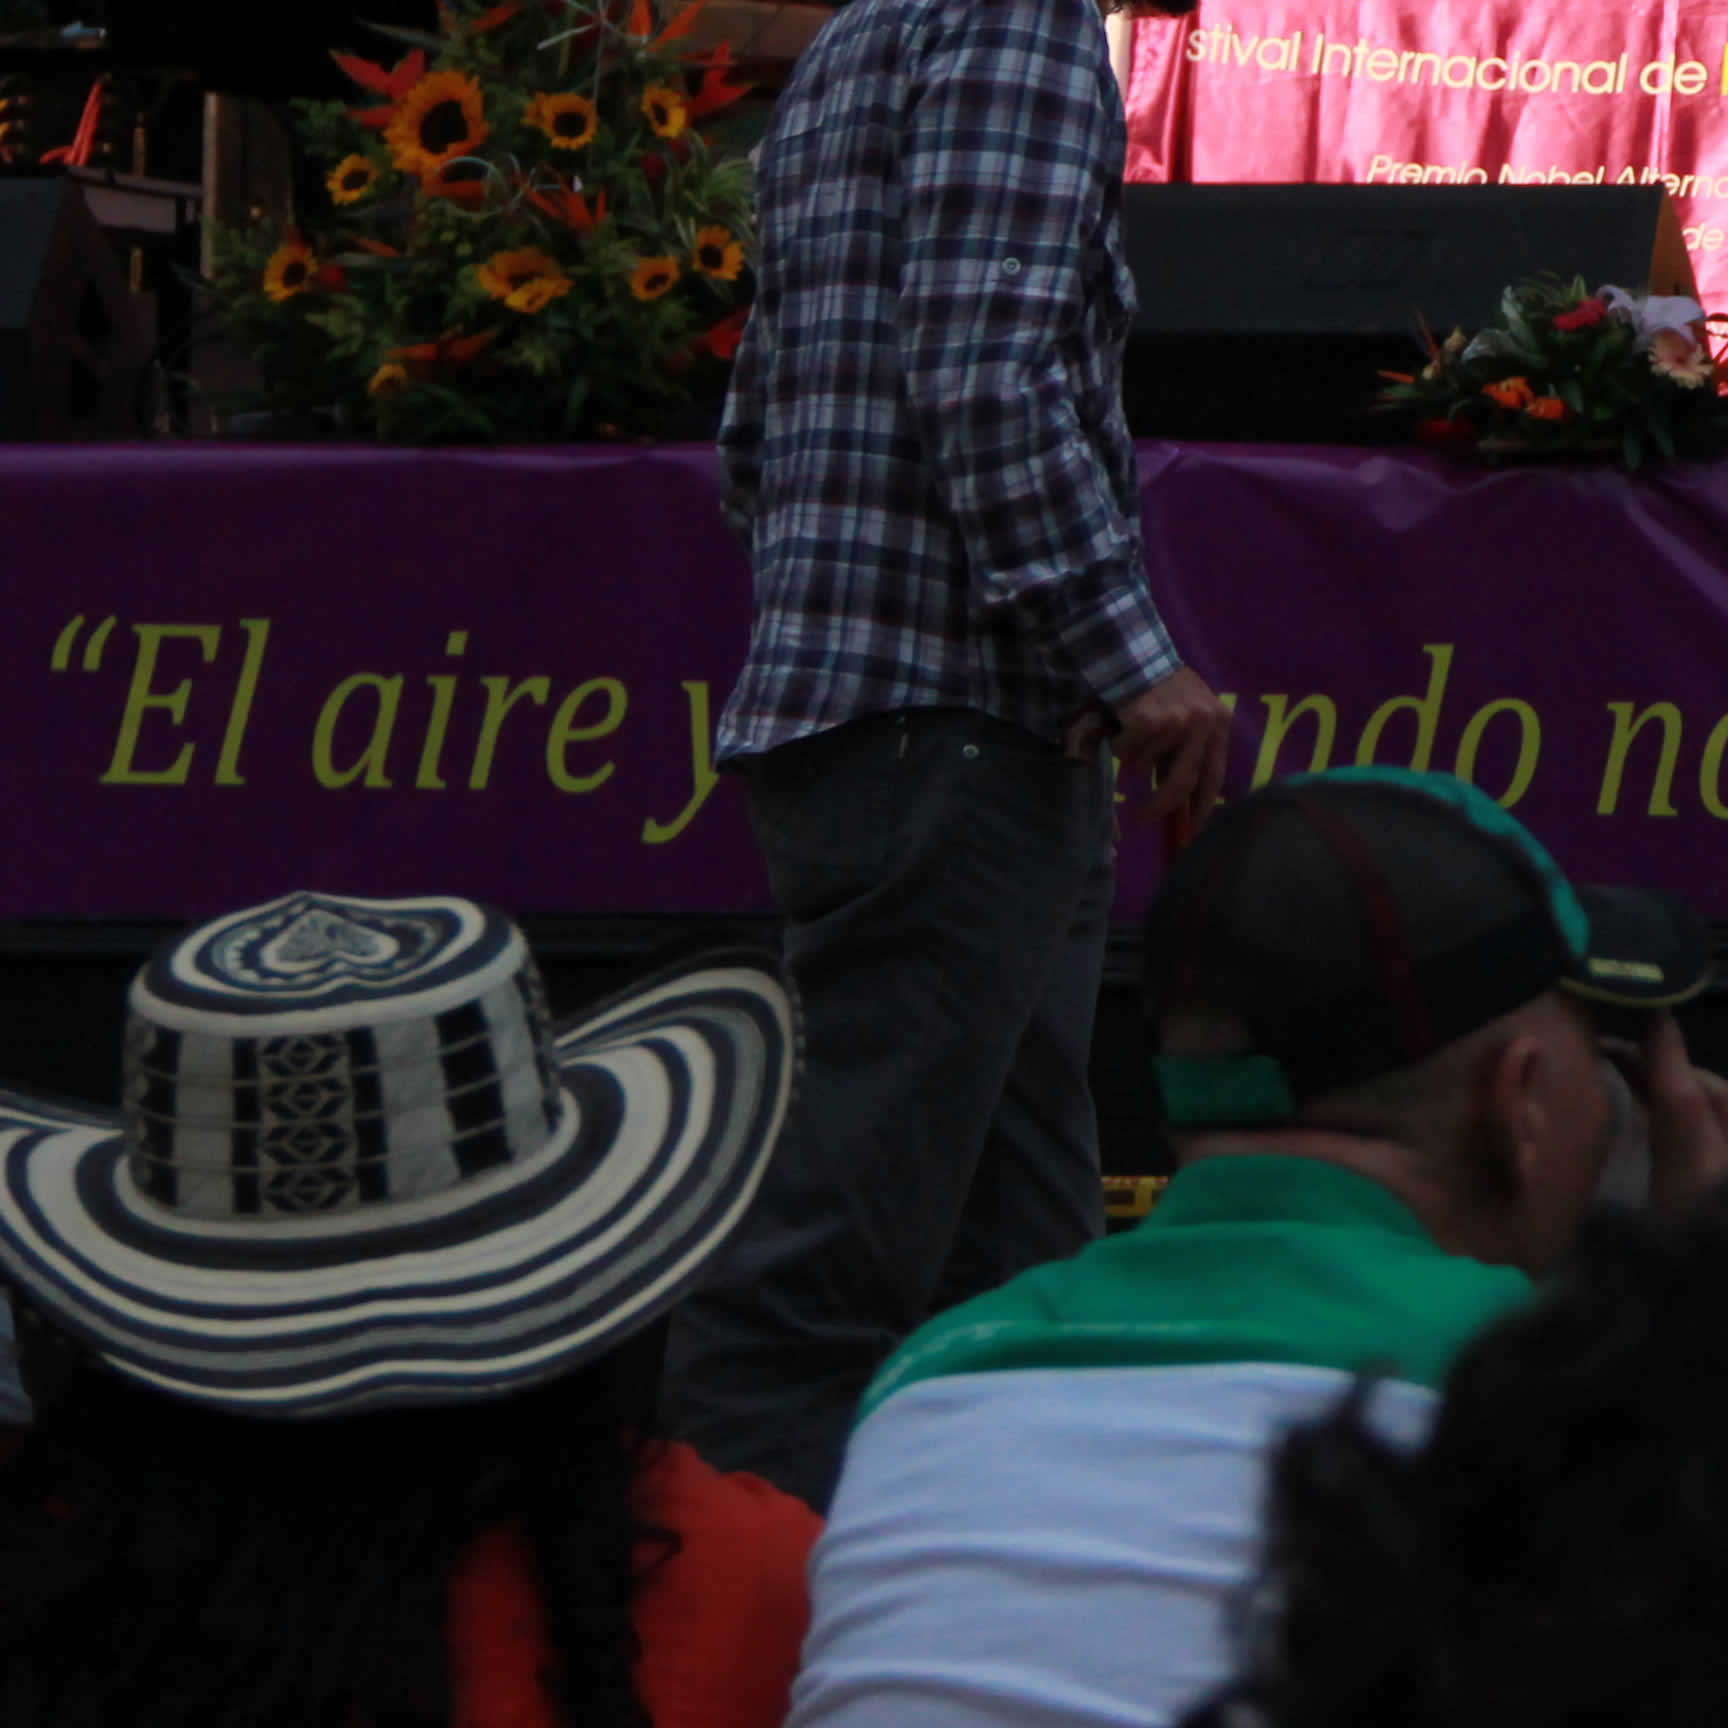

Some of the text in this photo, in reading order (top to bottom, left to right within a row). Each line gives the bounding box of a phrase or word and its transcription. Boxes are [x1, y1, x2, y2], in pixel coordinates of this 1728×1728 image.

[1185, 23, 1301, 72] stival
[1311, 33, 1628, 95] Internacional
[1640, 52, 1708, 95] de
[50, 613, 271, 786] “El
[311, 630, 628, 794] aire
